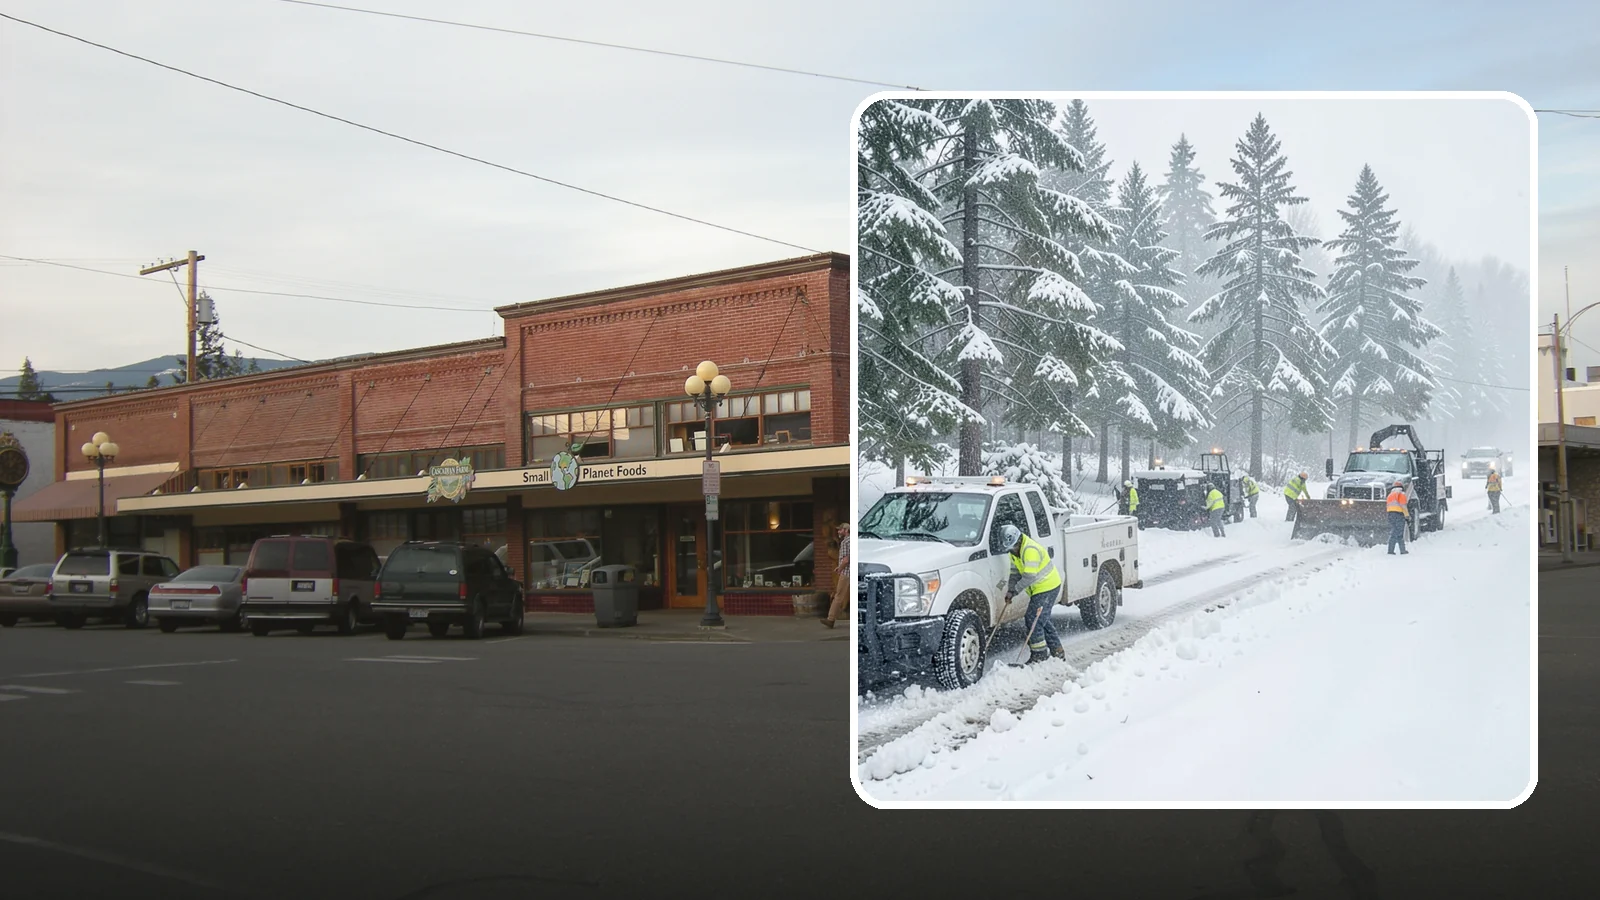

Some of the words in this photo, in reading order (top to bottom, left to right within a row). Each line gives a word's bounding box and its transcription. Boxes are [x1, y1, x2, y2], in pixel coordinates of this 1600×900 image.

[523, 471, 549, 483] Small
[583, 467, 614, 479] Planet
[617, 464, 647, 477] Foods
